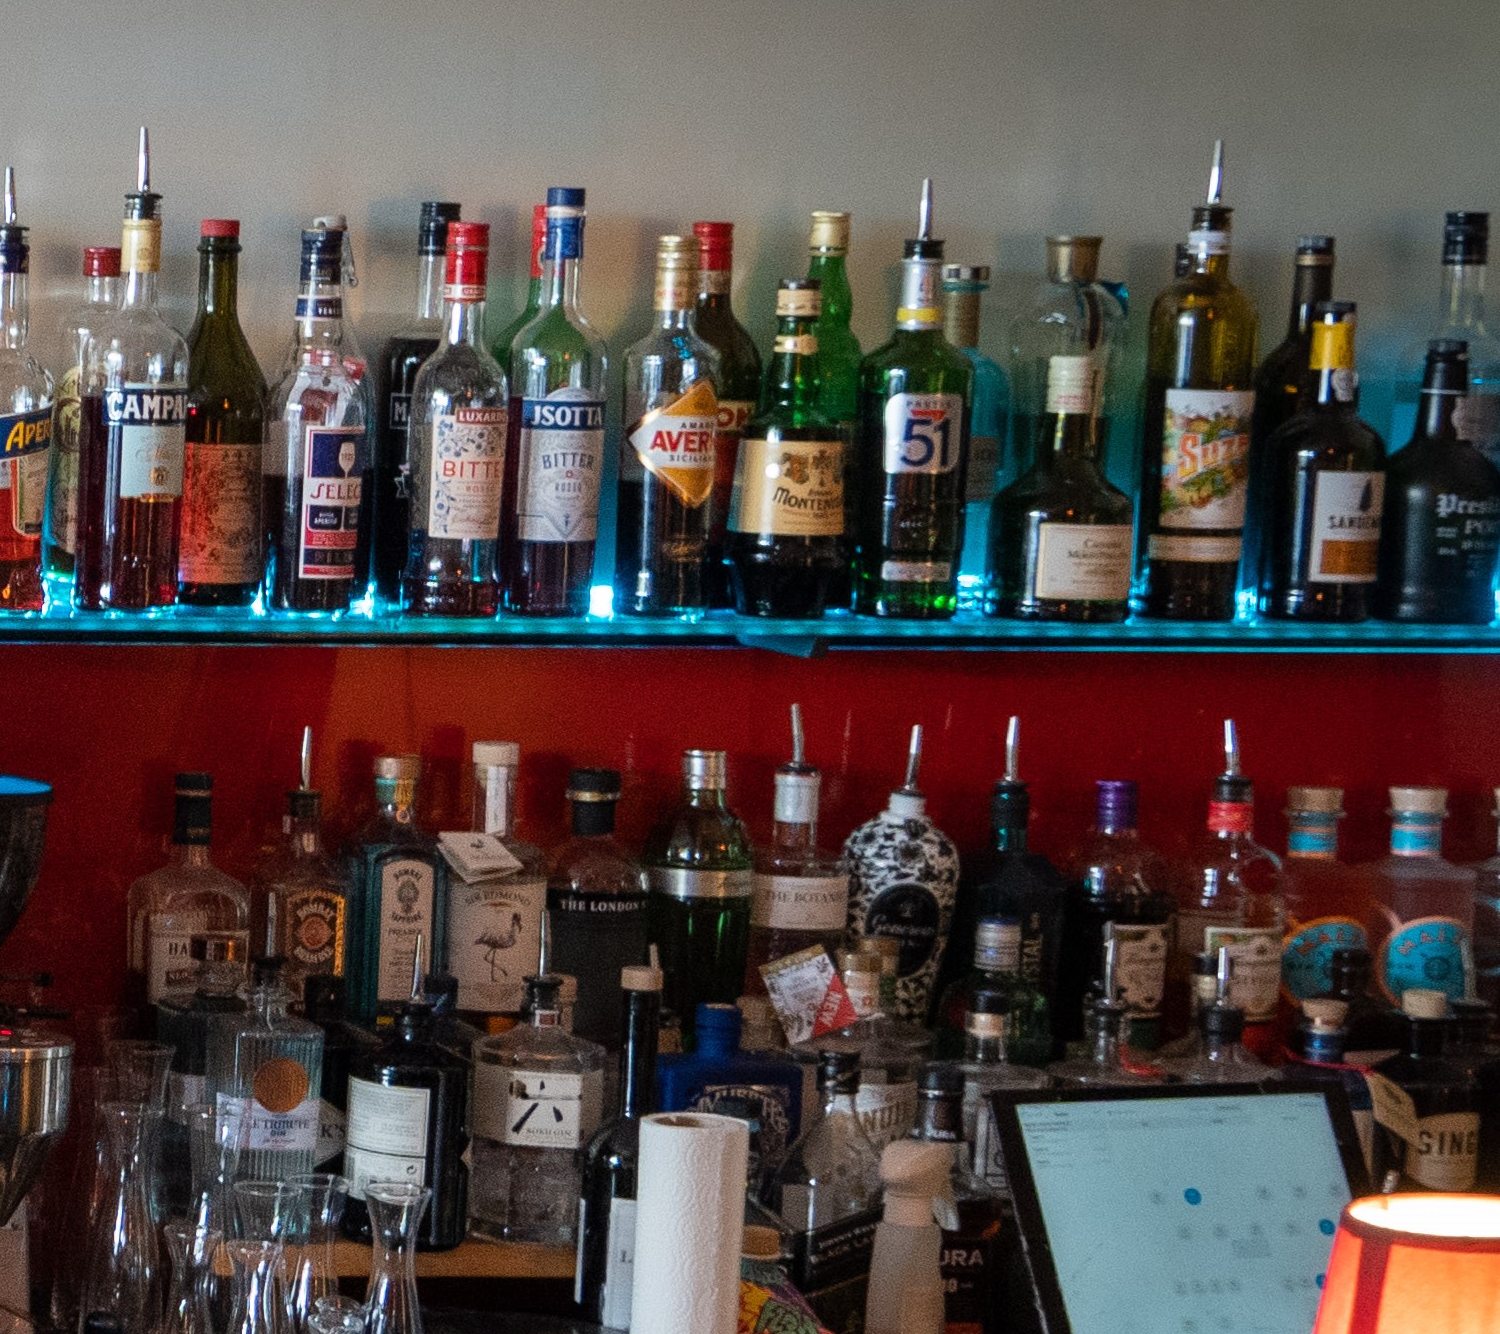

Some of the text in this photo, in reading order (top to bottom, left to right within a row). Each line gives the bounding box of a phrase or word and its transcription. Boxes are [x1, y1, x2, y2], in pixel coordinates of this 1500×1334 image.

[531, 405, 603, 427] JSOTTA
[900, 418, 950, 468] 51
[541, 450, 596, 471] BITTER
[560, 899, 587, 912] THE
